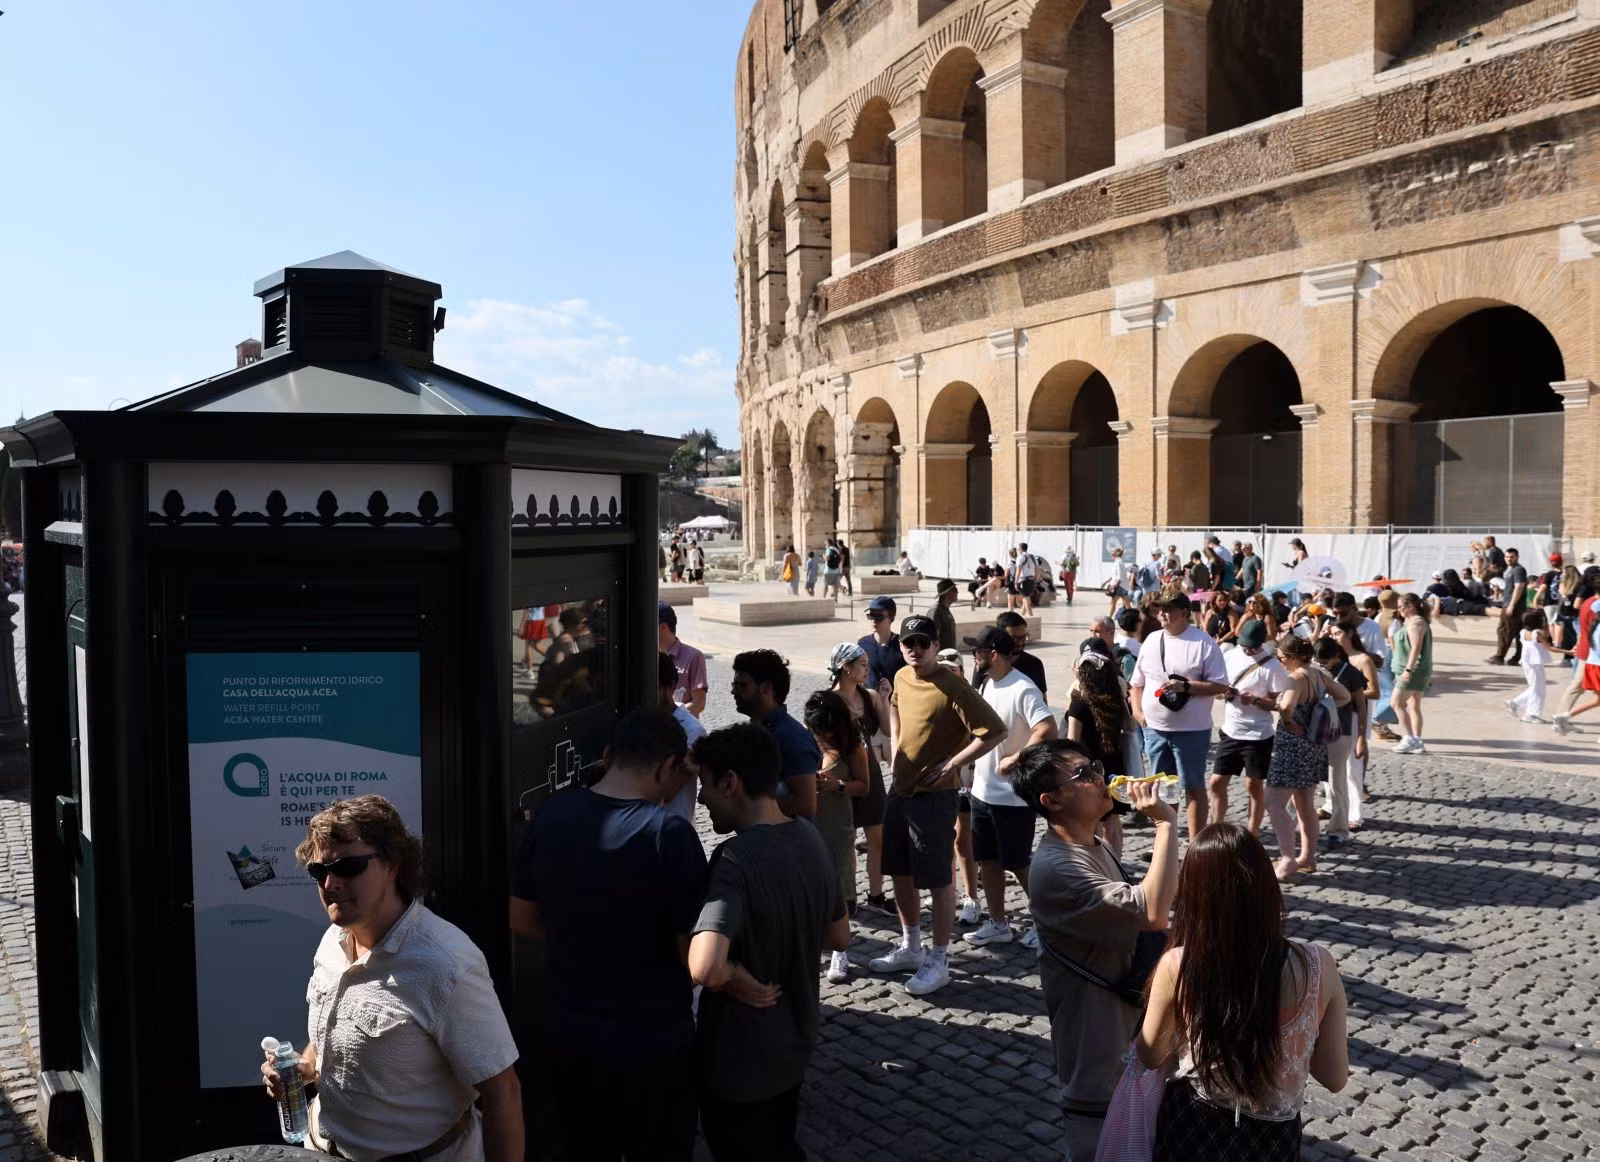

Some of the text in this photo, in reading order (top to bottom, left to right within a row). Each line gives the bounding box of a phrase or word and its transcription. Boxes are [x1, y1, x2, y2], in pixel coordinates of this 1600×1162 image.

[223, 676, 383, 686] PUNTO DI RIFORNIMENTO IDRICO
[223, 688, 338, 698] CASA DELL'ACQUA ACEA
[223, 703, 321, 713] WATER REFILL POINT
[224, 714, 325, 724] ACEA WATER CENTRE
[279, 771, 388, 785] L'ACQUA DI ROMA
[289, 786, 313, 798] QUI
[316, 786, 339, 796] PER
[341, 785, 355, 795] TE
[280, 802, 326, 813] ROME'S
[281, 816, 292, 827] IS
[261, 843, 287, 852] Sicura
